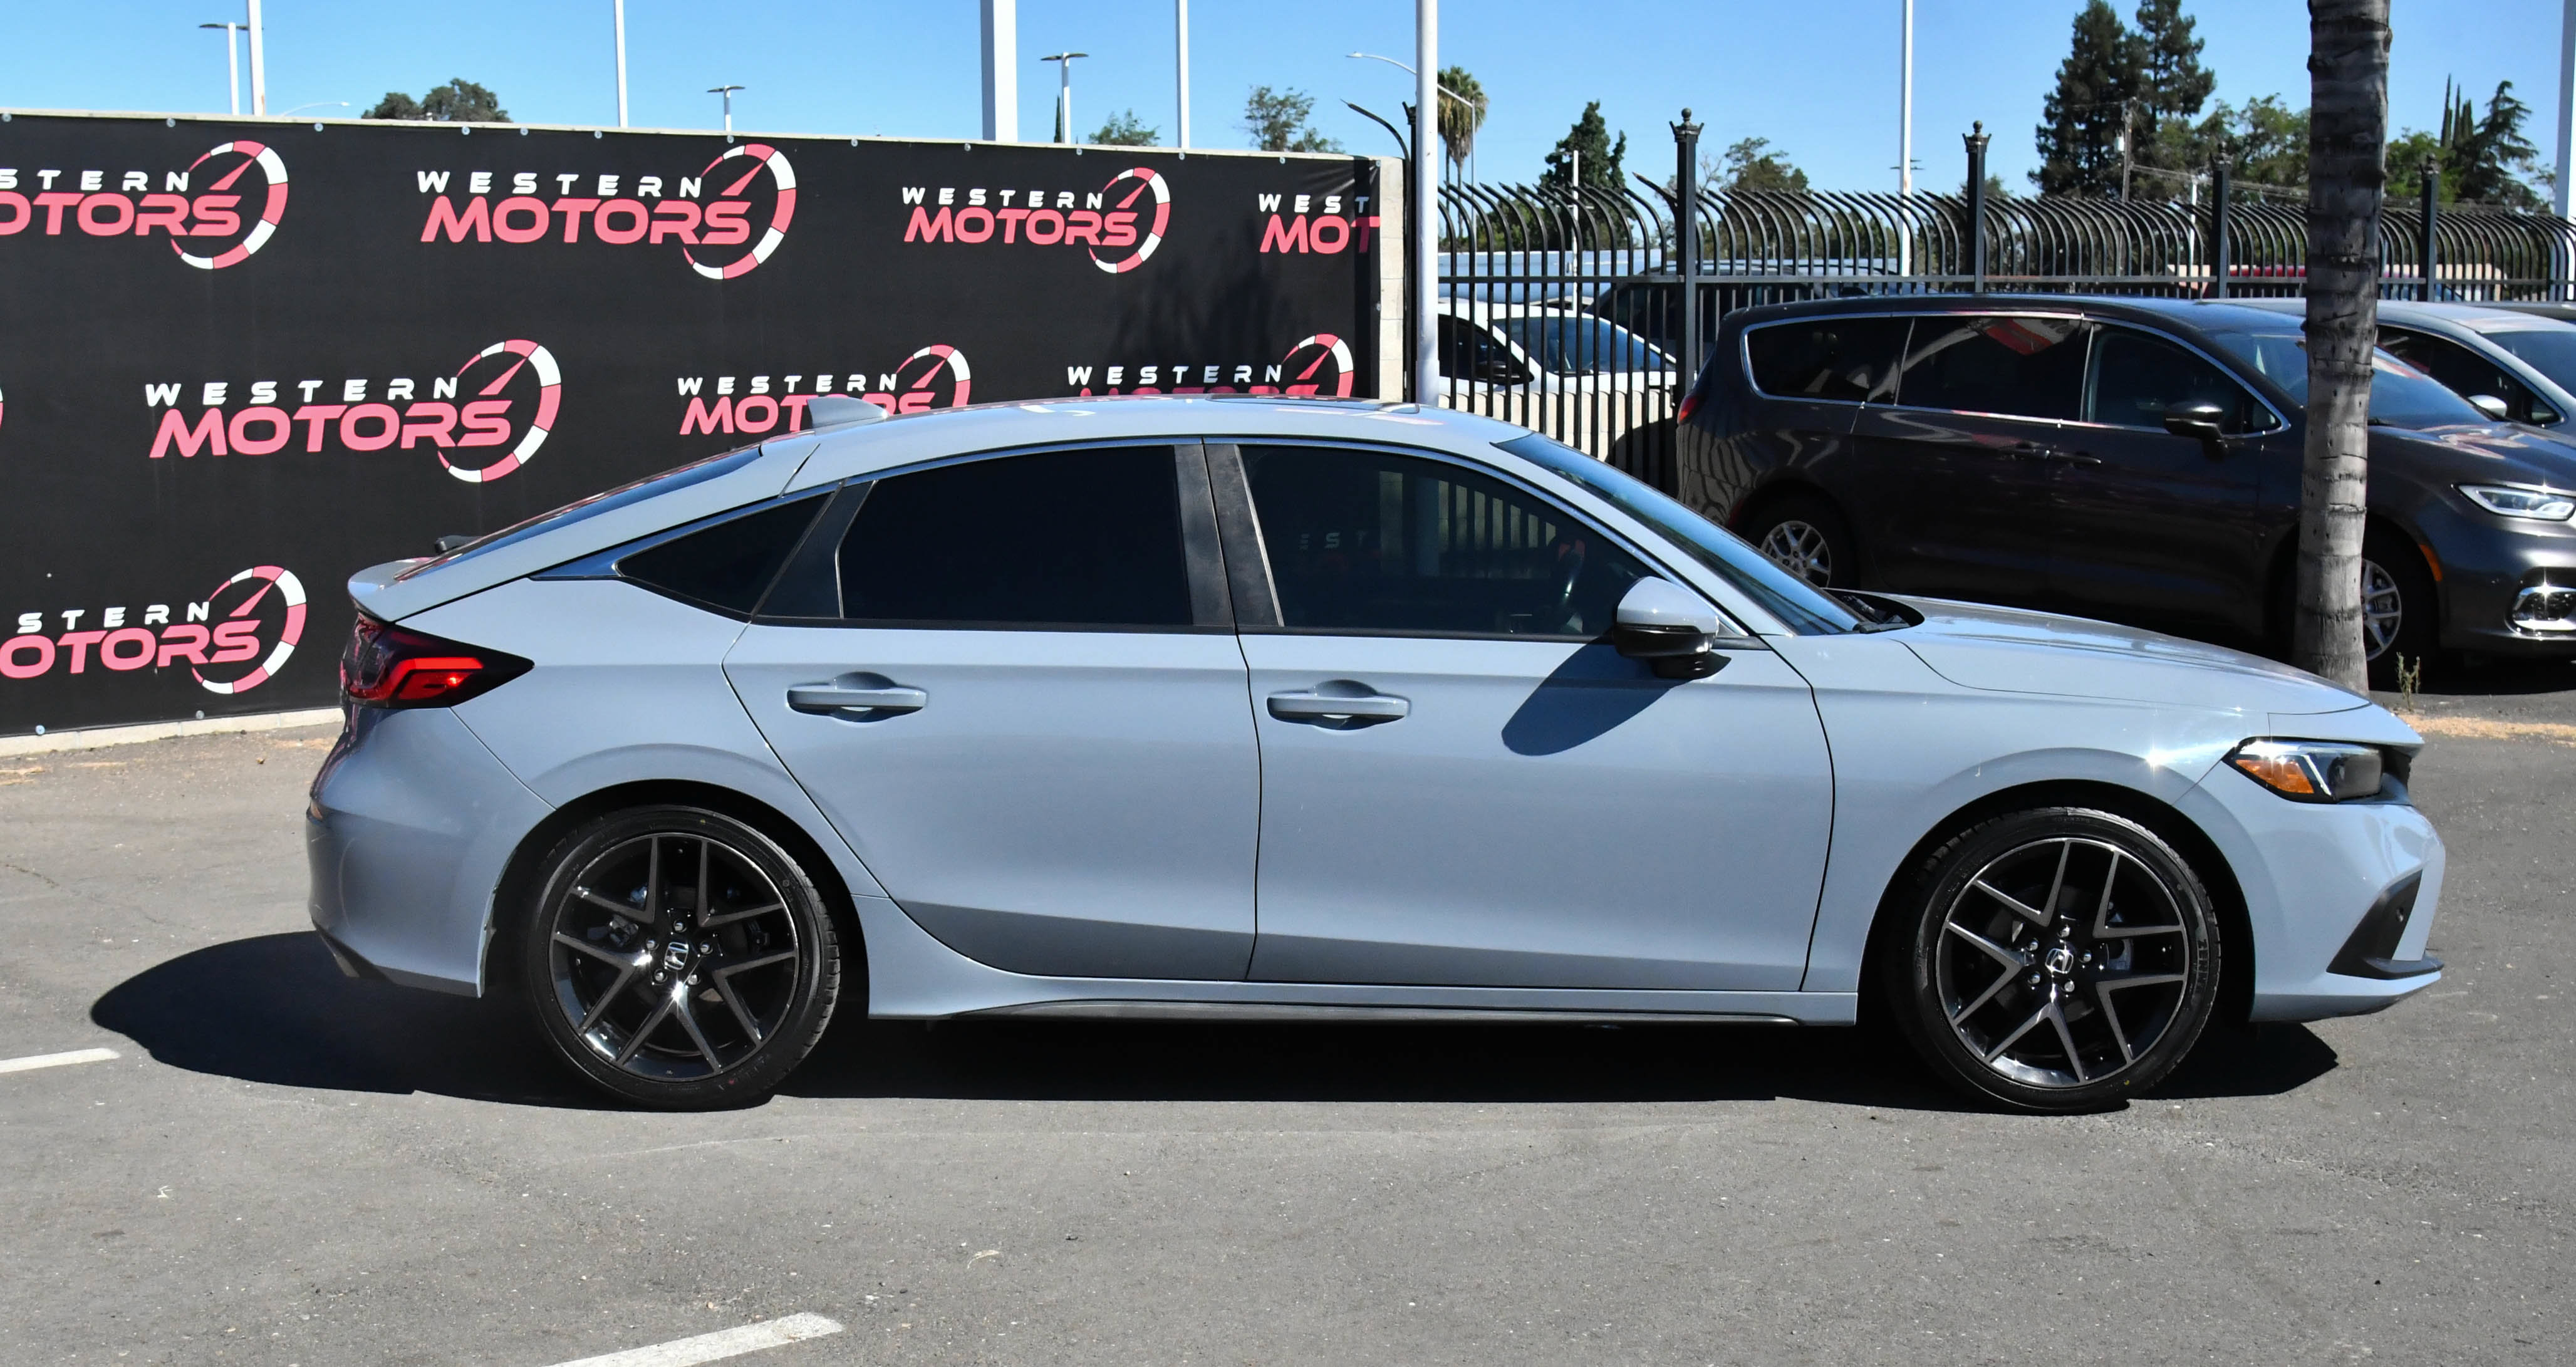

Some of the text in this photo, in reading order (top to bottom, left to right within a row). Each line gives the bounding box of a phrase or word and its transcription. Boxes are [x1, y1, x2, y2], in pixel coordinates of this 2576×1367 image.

[417, 170, 702, 198] WESTERN
[902, 187, 1103, 210] WESTERN
[1259, 193, 1370, 214] WEST
[420, 195, 752, 245] MOTORS
[904, 205, 1138, 247] MOTORS
[1259, 214, 1381, 254] MOT
[677, 373, 897, 396] WESTERN
[1067, 364, 1282, 385] WESTERN
[145, 377, 458, 407] WESTERN
[679, 392, 936, 435] MOTS
[149, 400, 512, 460] MOTORS
[16, 601, 209, 635] STERN
